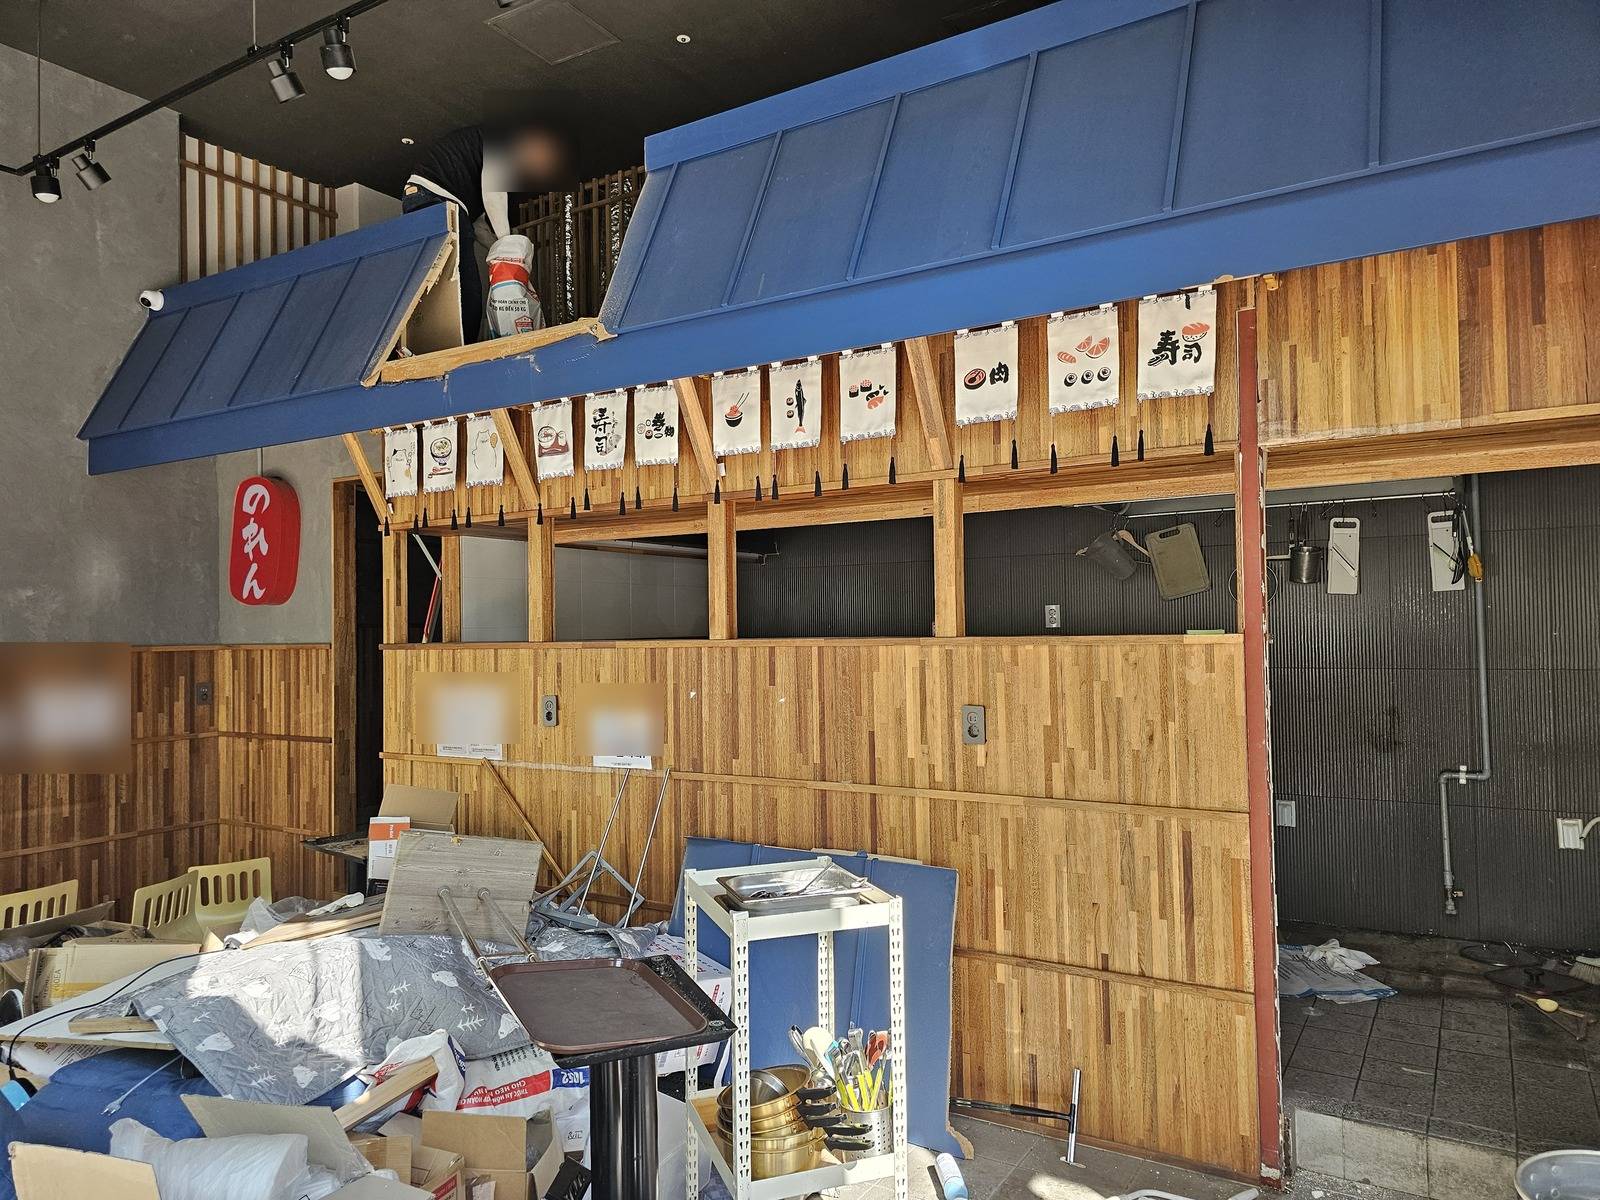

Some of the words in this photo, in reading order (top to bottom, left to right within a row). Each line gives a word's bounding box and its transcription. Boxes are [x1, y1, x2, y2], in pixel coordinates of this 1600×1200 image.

[1152, 329, 1202, 365] 寿司
[989, 361, 1010, 385] 肉
[591, 408, 612, 453] 寿司
[242, 484, 271, 600] のれん
[512, 1080, 526, 1090] CHO
[561, 1071, 586, 1084] 1052
[495, 1085, 510, 1095] HEO
